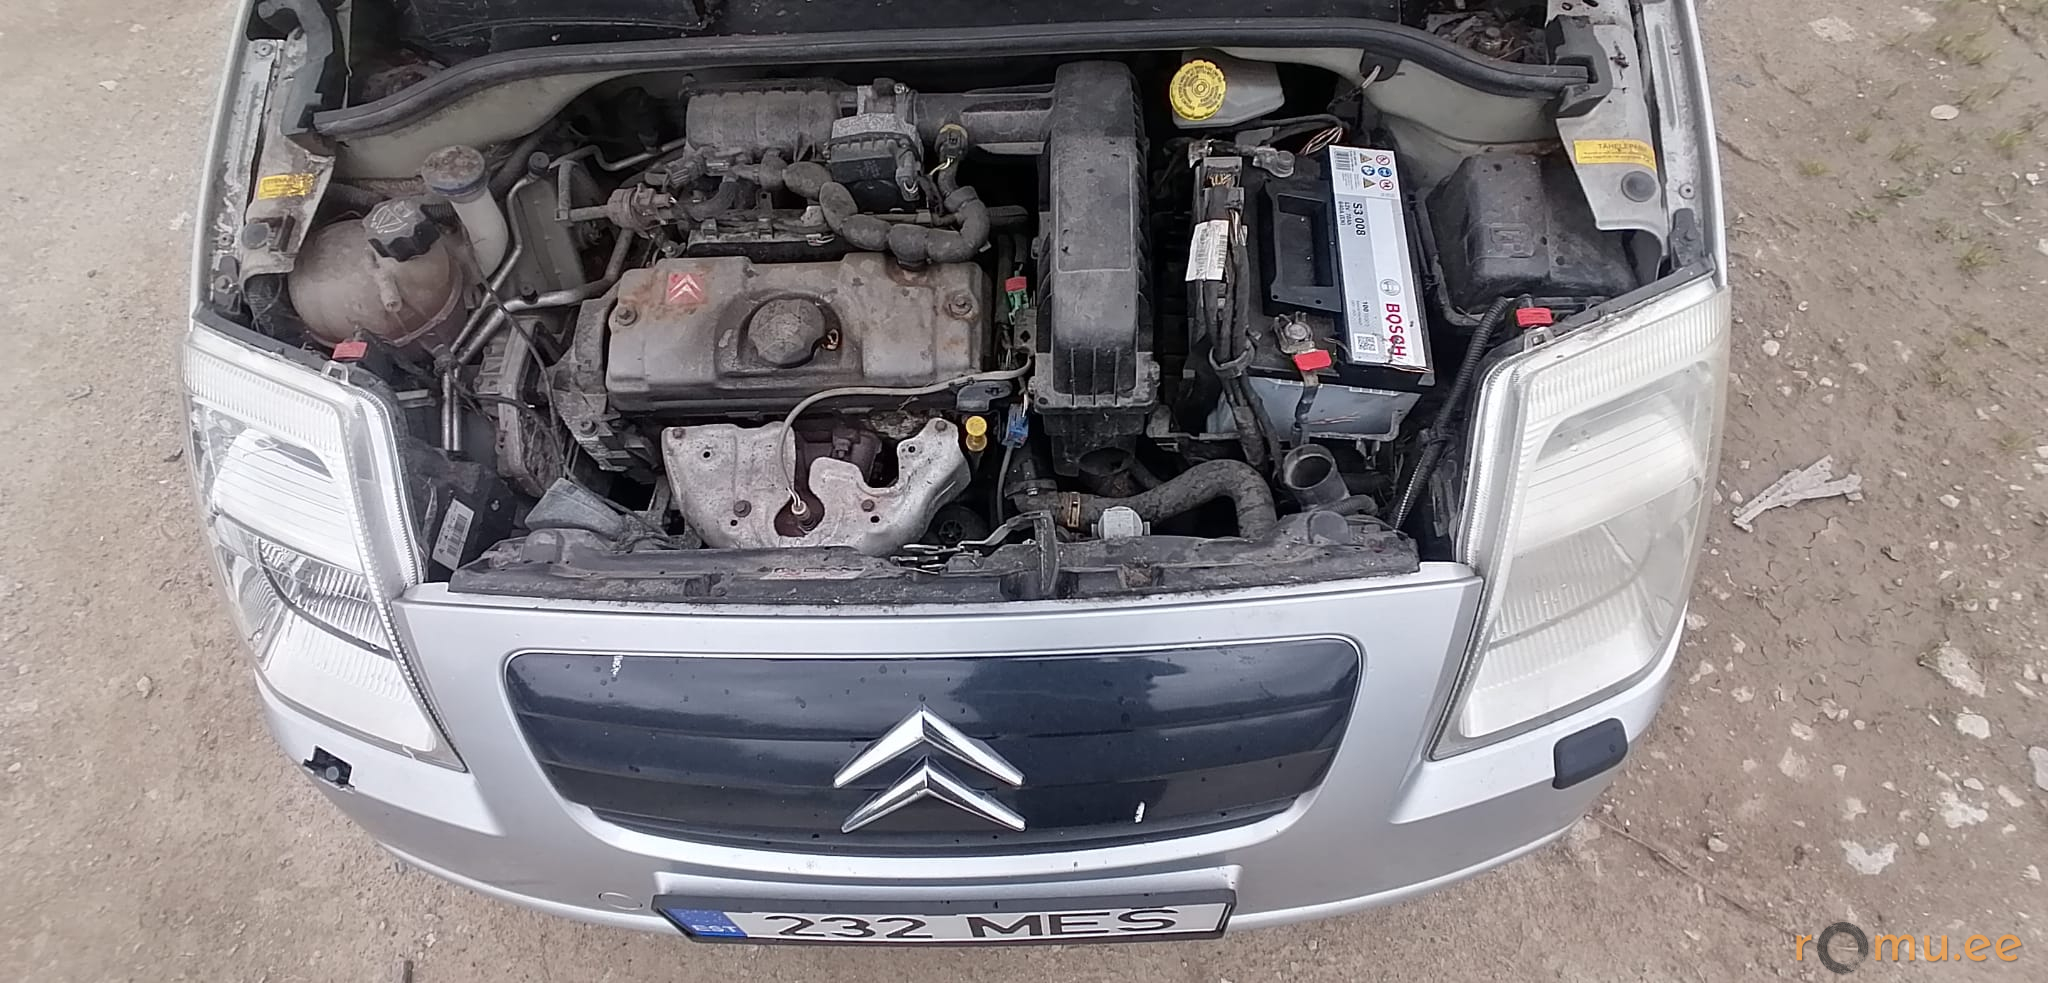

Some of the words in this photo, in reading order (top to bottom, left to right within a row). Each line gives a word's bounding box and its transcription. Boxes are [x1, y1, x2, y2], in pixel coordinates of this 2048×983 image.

[1353, 202, 1364, 215] S3
[1355, 217, 1366, 236] 008
[1385, 303, 1407, 356] BOSCH
[691, 923, 737, 934] EST
[764, 915, 933, 939] 232
[966, 908, 1179, 938] MES
